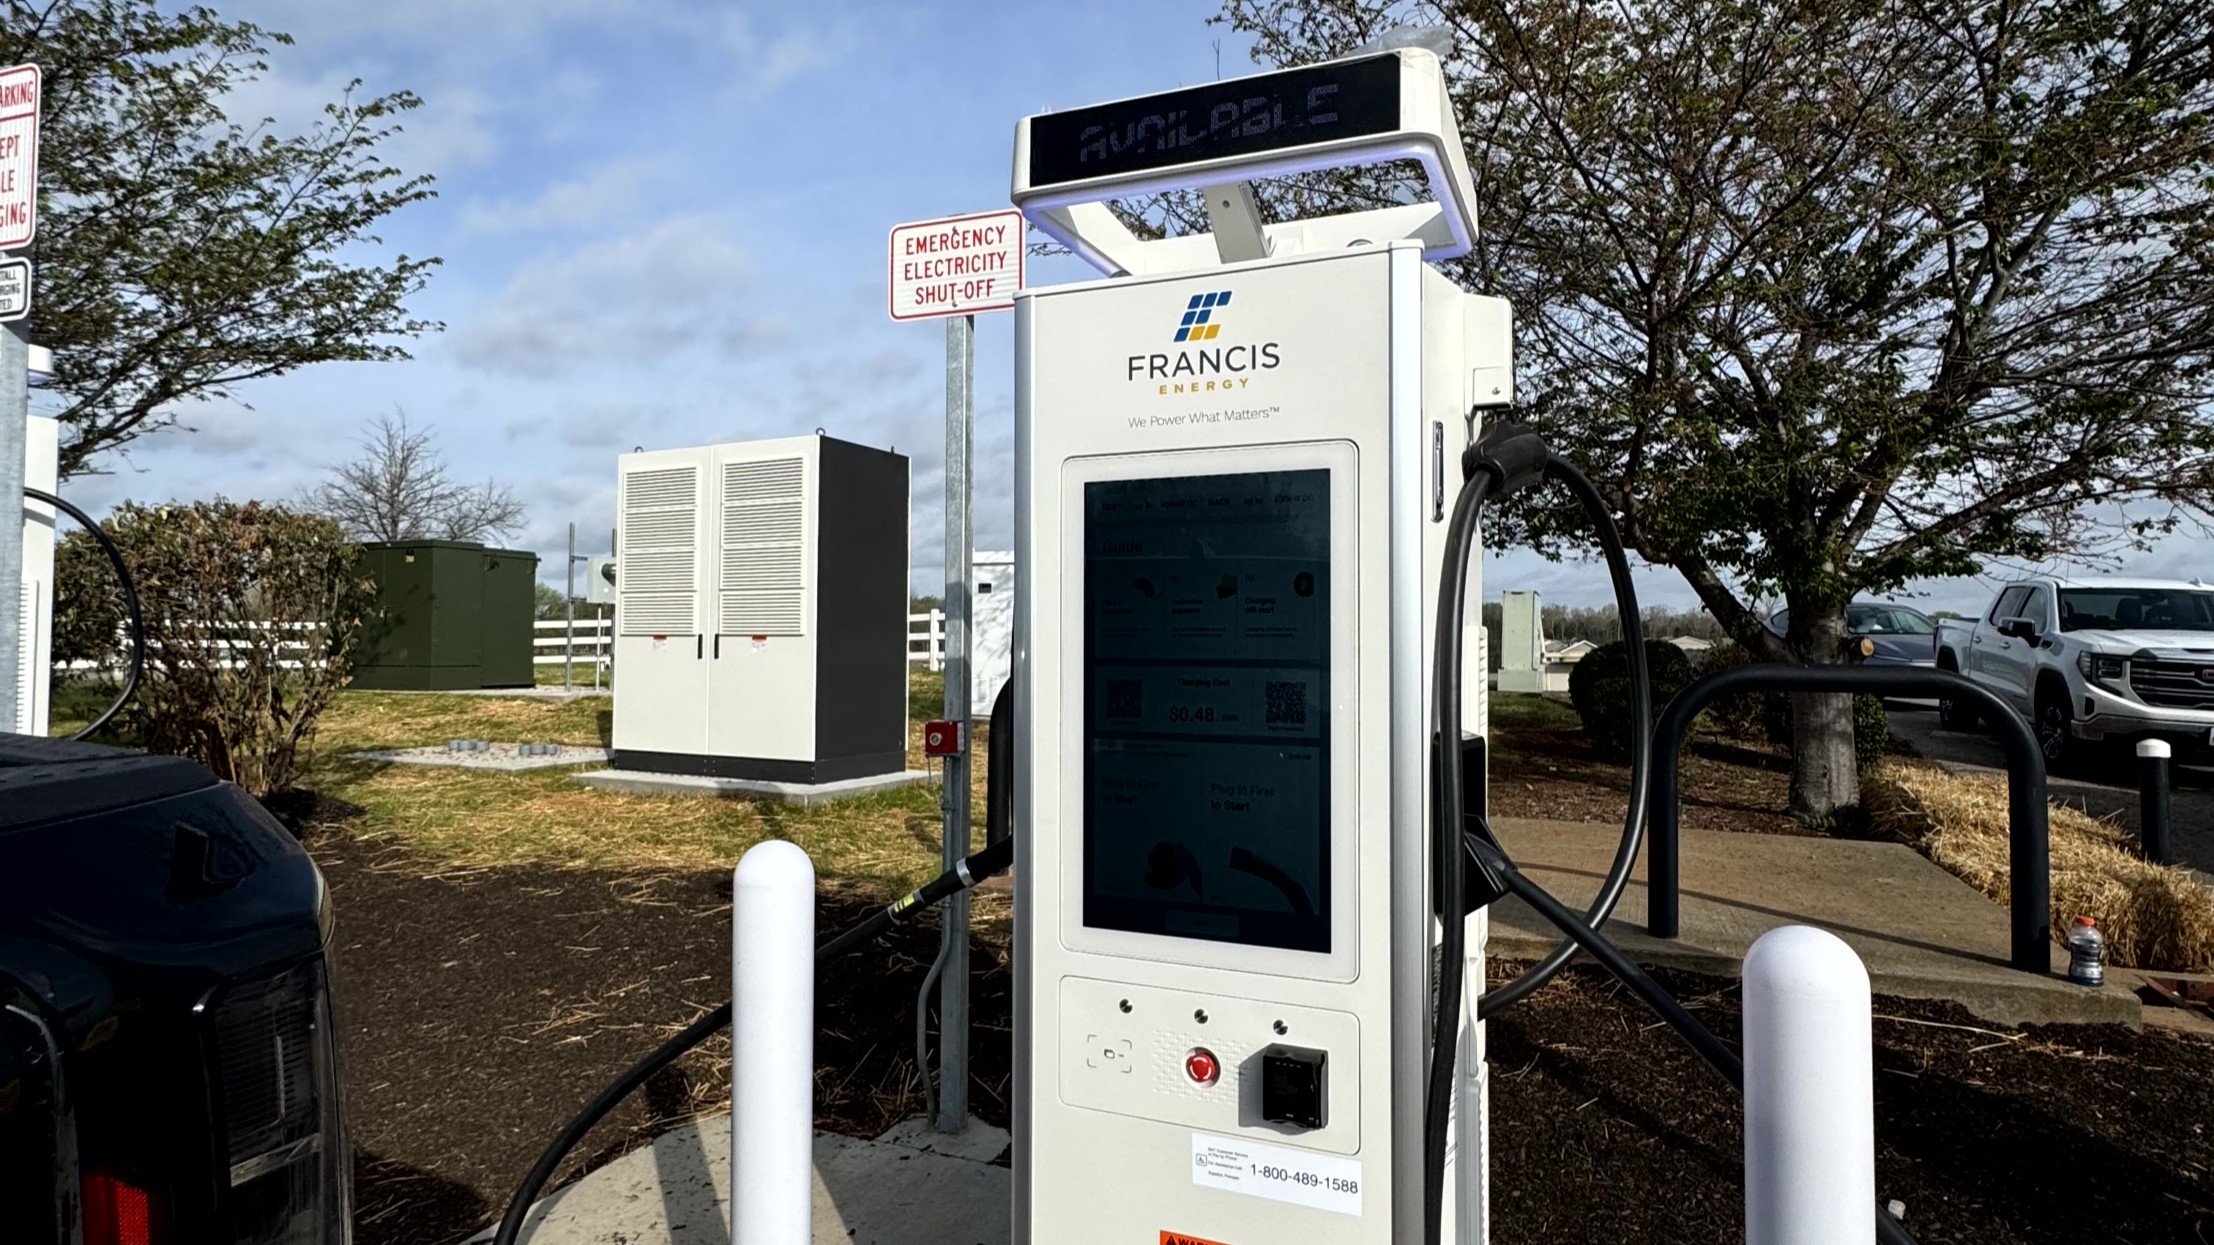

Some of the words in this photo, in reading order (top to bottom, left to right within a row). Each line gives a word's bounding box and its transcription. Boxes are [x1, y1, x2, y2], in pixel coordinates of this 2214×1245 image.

[1079, 84, 1340, 163] AVAILABLE
[905, 225, 1006, 256] EMERGENCY
[904, 250, 1007, 281] ELECTRICITY
[915, 277, 996, 305] SHUT-OFF
[1128, 342, 1281, 381] FRANCIS
[1159, 377, 1249, 395] ENERGY
[1128, 416, 1147, 428] We
[1150, 414, 1187, 428] Power
[1189, 411, 1221, 424] What
[1102, 538, 1143, 554] Guide
[1177, 678, 1211, 688] Charging
[1212, 678, 1231, 688] Cost
[1168, 704, 1215, 722] $0.48
[1210, 782, 1235, 797] Plug
[1249, 784, 1275, 797] First
[1210, 799, 1222, 810] to
[1223, 800, 1250, 812] Start
[1250, 1162, 1360, 1195] 1-800-489-1588
